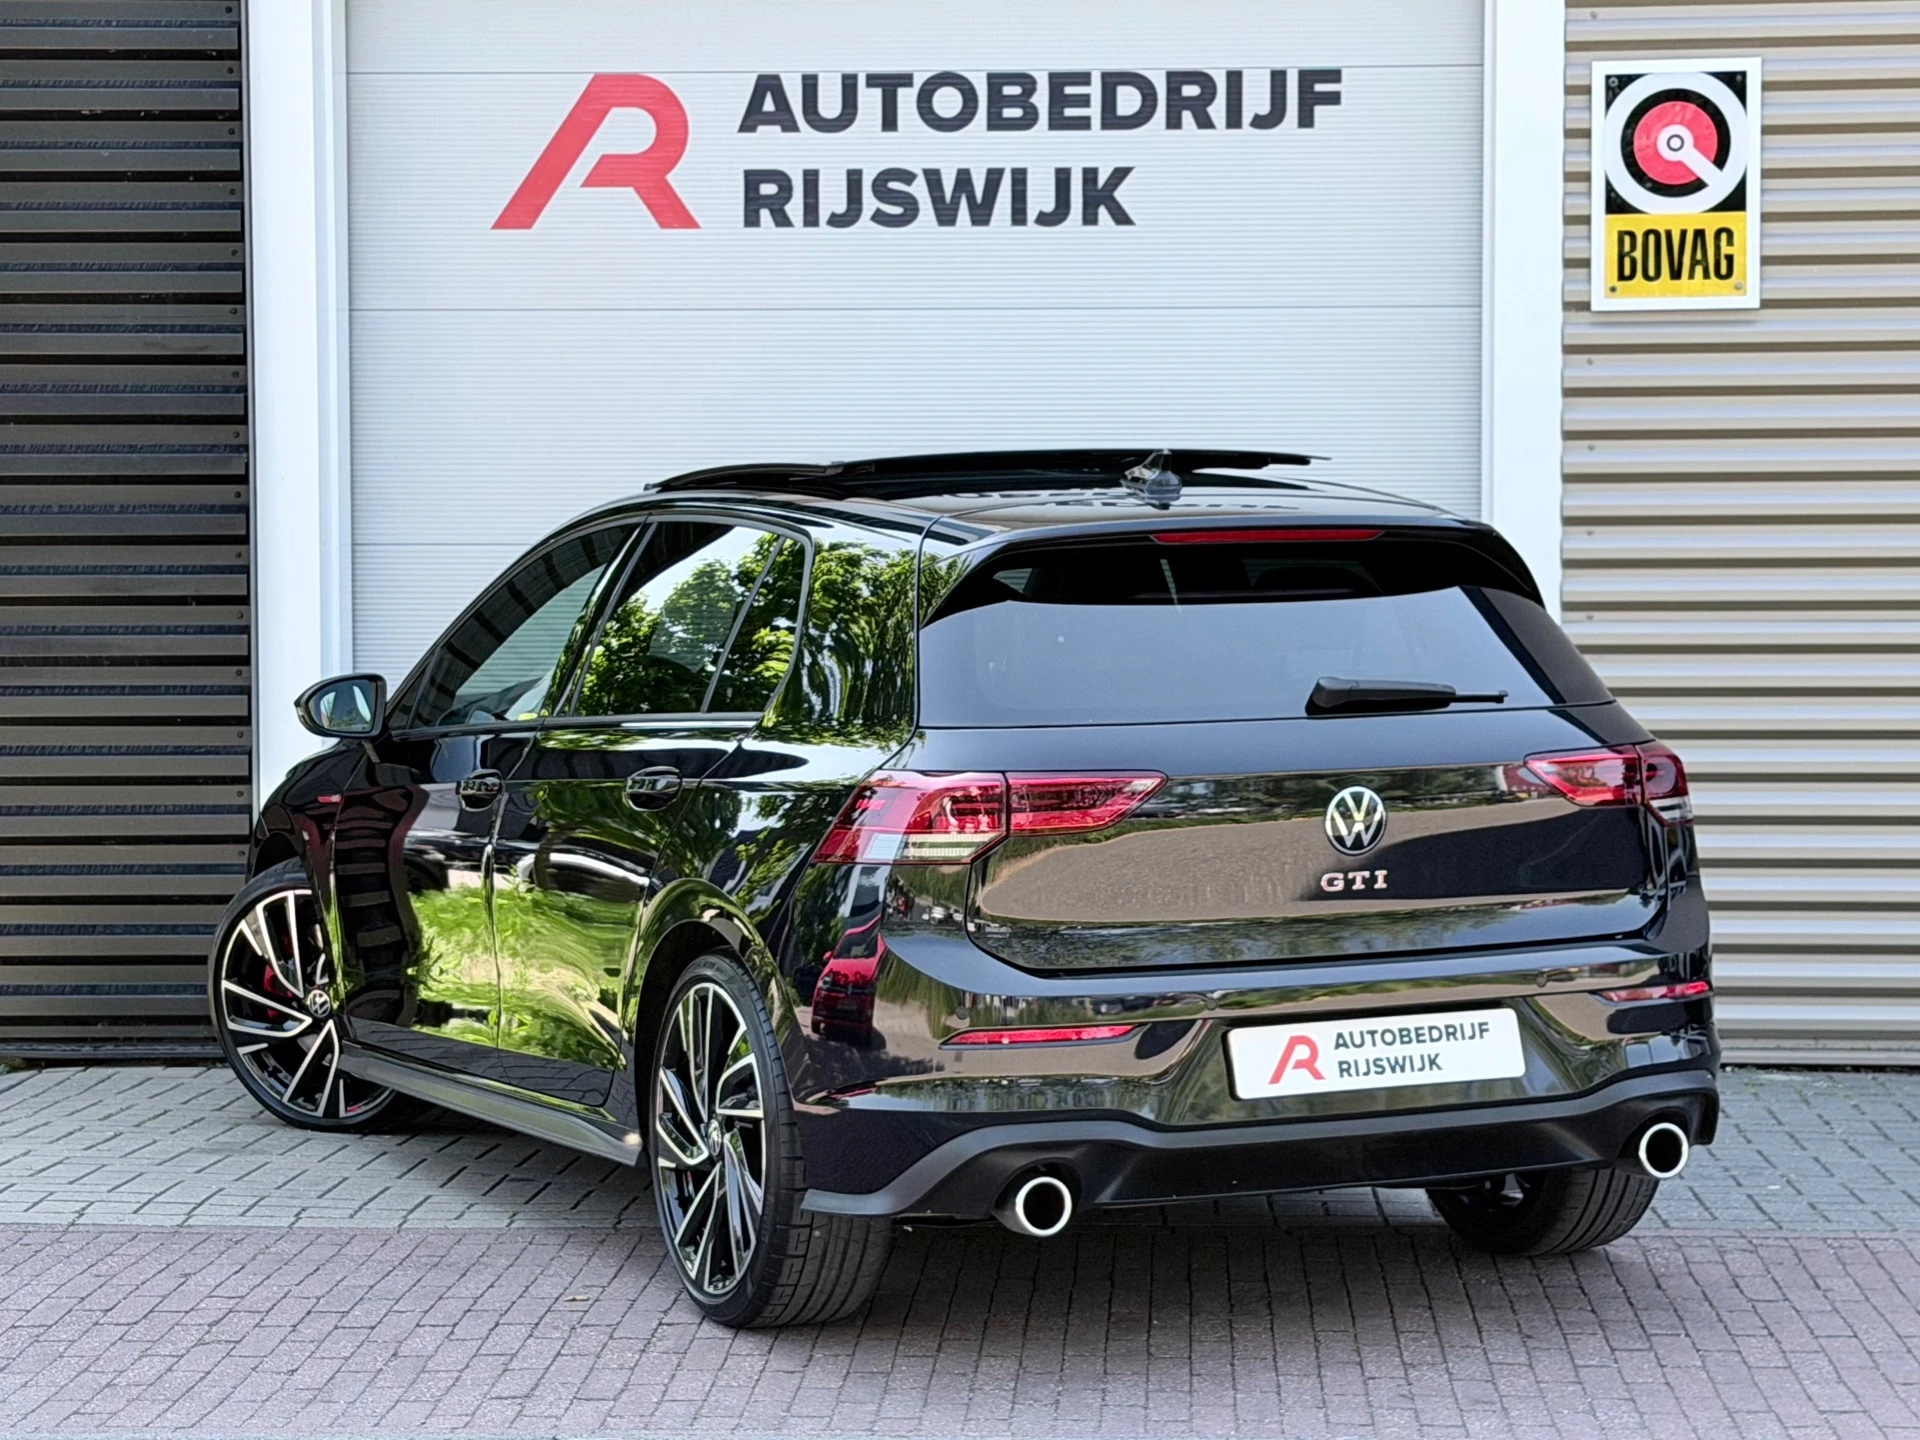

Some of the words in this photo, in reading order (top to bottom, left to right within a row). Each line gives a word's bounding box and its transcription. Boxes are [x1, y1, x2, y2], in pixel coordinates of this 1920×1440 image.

[737, 68, 1343, 134] AUTOBEDRIJF
[743, 166, 1137, 228] RIJSWIJK
[1616, 226, 1735, 283] BOVAG
[1320, 869, 1389, 893] GTI
[1333, 1021, 1491, 1051] AUTOBEDRIJF
[1337, 1052, 1444, 1079] RIJSWIJK
